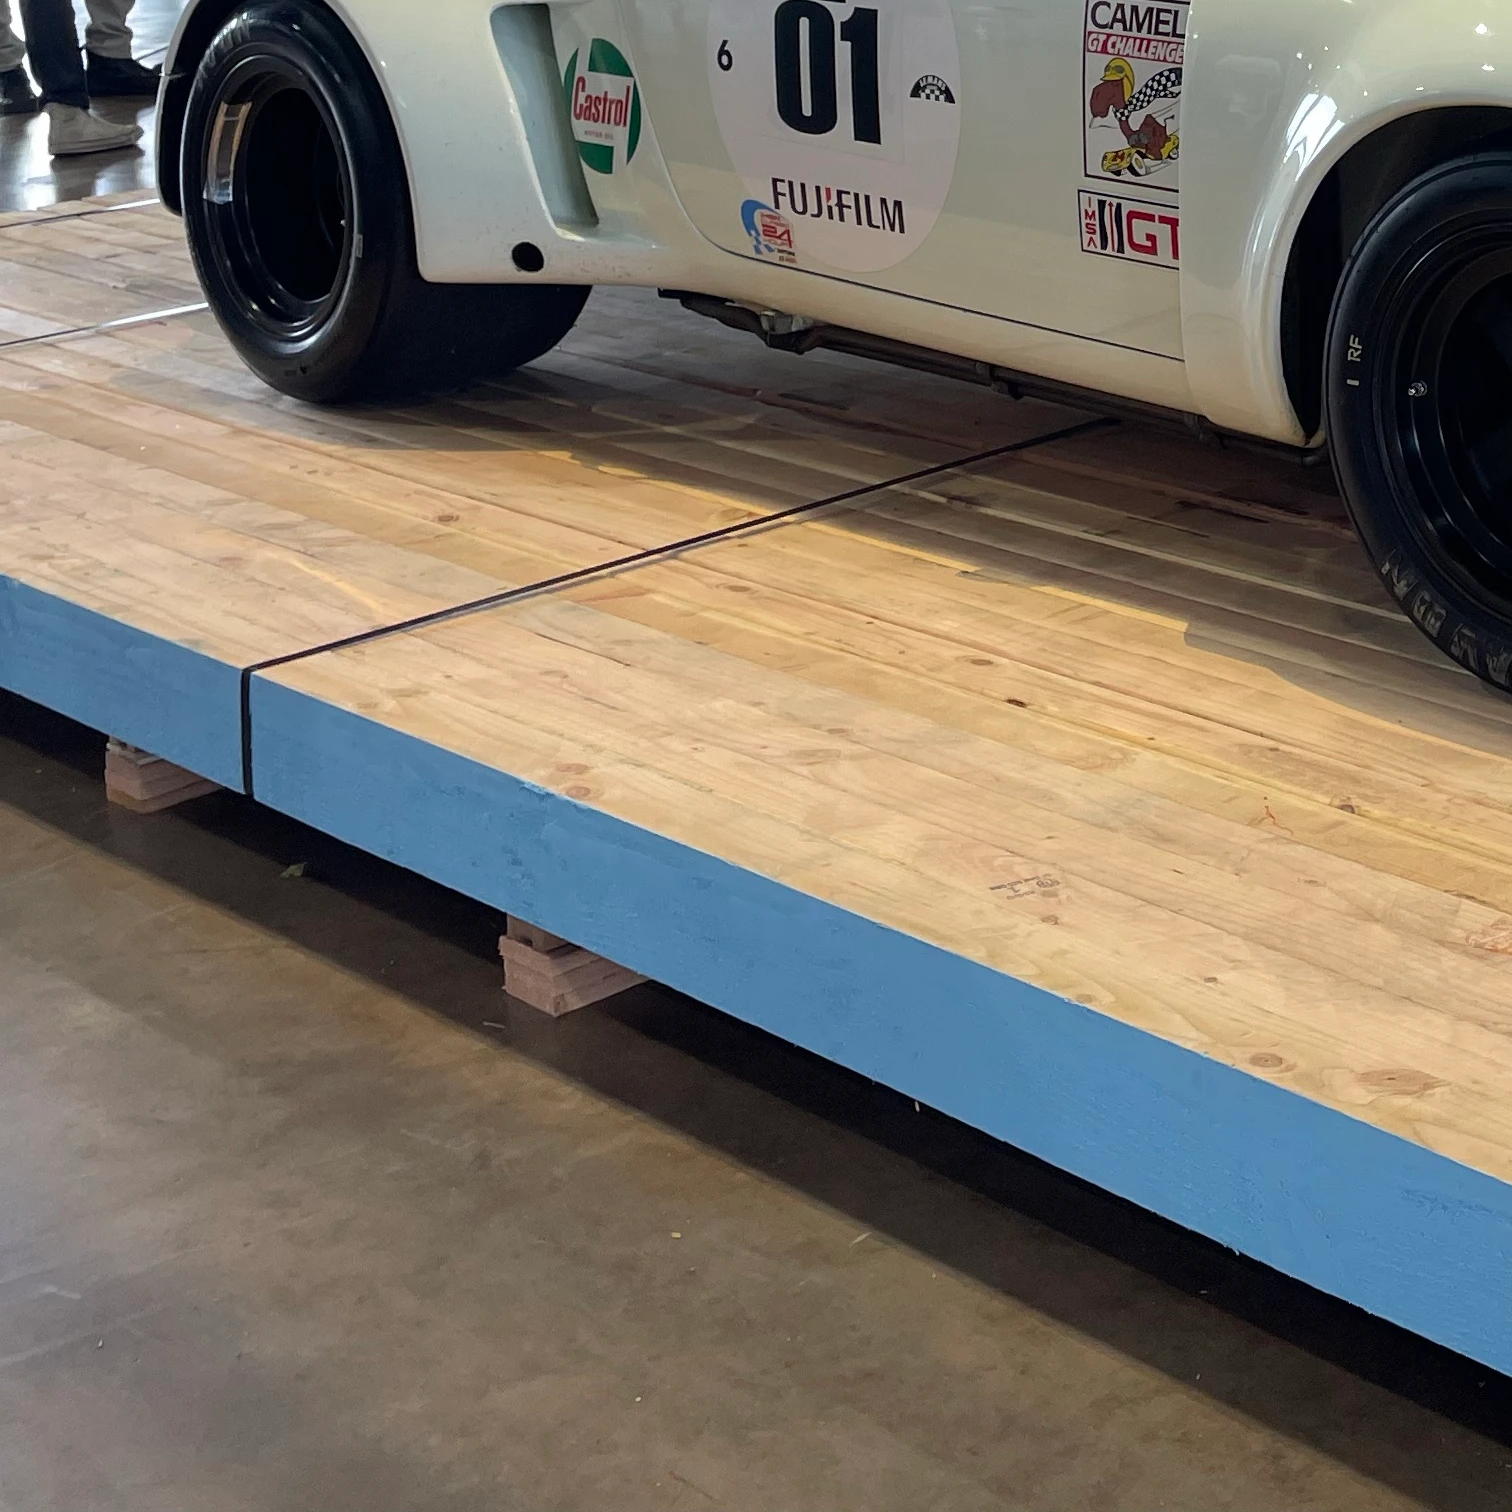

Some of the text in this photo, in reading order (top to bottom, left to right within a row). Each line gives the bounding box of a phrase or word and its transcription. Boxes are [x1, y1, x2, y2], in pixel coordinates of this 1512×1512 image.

[1090, 0, 1186, 39] CAMEL
[717, 39, 733, 72] 6
[1087, 33, 1184, 64] GT CHALLENGE
[774, 0, 882, 145] 01
[574, 75, 632, 128] Castrol
[772, 177, 906, 234] FUJIFILM
